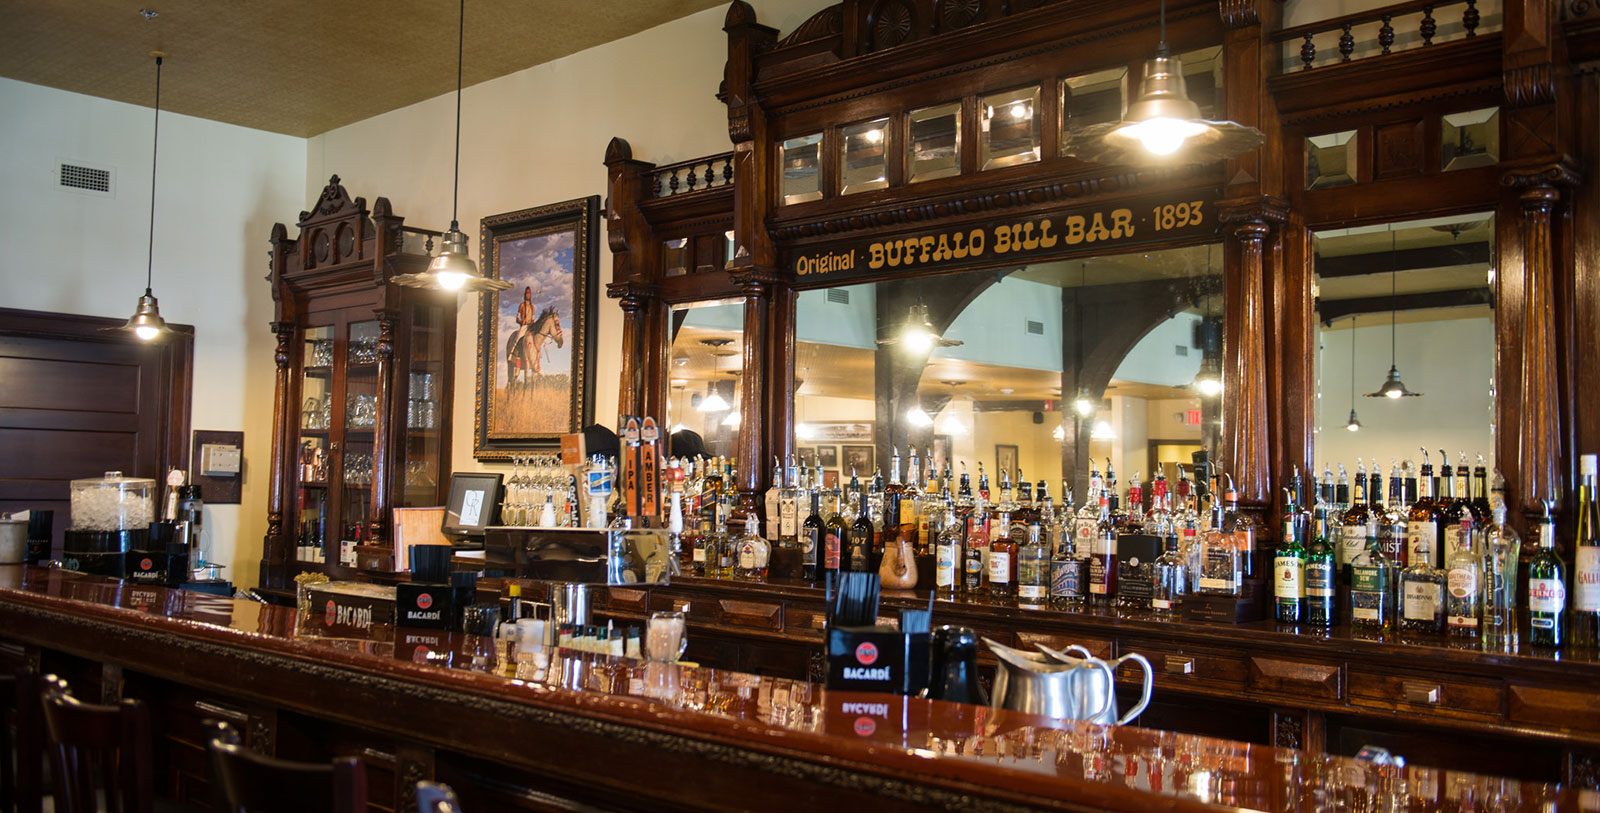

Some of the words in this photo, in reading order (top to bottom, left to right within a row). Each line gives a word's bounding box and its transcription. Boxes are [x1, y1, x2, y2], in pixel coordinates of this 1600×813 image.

[796, 249, 855, 276] Original
[868, 229, 986, 269] BUFFALO
[993, 220, 1058, 253] BILL
[1065, 208, 1135, 245] BAR
[1153, 201, 1204, 231] 1893
[645, 451, 654, 502] AMBER
[1379, 542, 1402, 554] MIST
[1275, 561, 1303, 569] JAMESN
[407, 610, 441, 620] BACARDÍ
[843, 666, 890, 680] BACARDÍ
